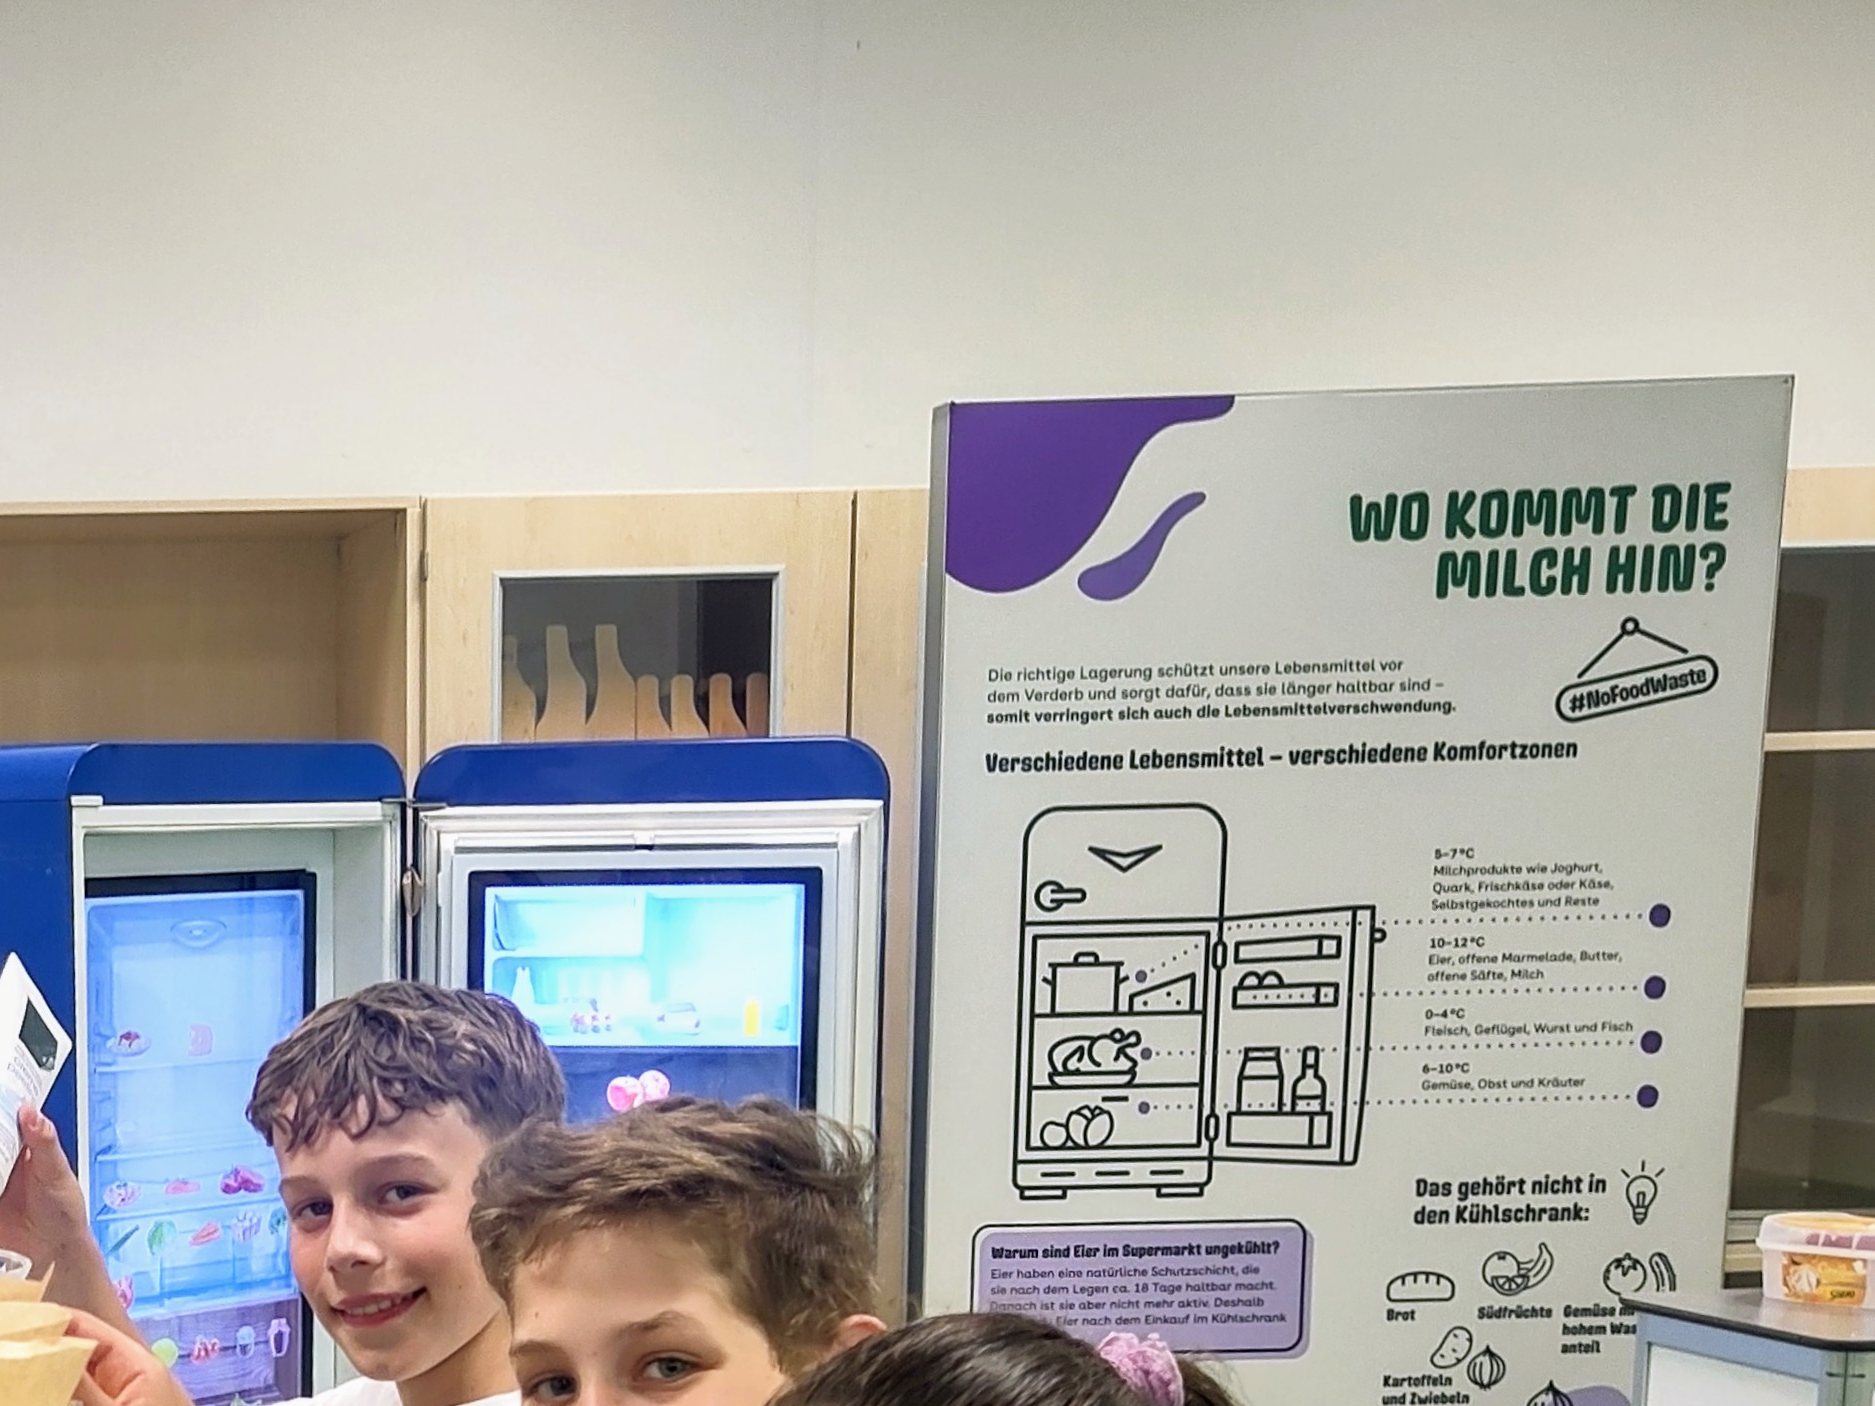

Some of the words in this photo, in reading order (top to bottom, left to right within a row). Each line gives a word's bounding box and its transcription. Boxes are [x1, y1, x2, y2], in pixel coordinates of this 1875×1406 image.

[1350, 492, 1429, 542] WO
[1445, 485, 1637, 539] KOMMT
[1652, 482, 1731, 533] DIE
[1436, 547, 1591, 599] MILCH
[1606, 542, 1725, 594] HIN?
[989, 669, 1012, 682] Die
[1017, 667, 1074, 683] richtige
[1080, 666, 1152, 682] Lagerung
[1157, 664, 1214, 677] schützt
[1220, 665, 1270, 675] unsere
[1275, 659, 1374, 674] Lebensmittel
[1380, 660, 1403, 671] vor
[987, 690, 1019, 703] dem
[1025, 688, 1083, 702] Verderb
[1088, 686, 1116, 700] und
[1121, 686, 1160, 702] sorgt
[1166, 684, 1211, 699] dafür,
[1215, 683, 1251, 697] dass
[1256, 683, 1276, 696] sie
[1281, 681, 1331, 697] länger
[1337, 680, 1394, 694] haltbar
[1400, 678, 1430, 691] sind
[1569, 666, 1707, 714] #NoFoodWaste
[987, 710, 1030, 723] somit
[1035, 708, 1113, 724] verringert
[1118, 706, 1148, 720] sich
[1154, 706, 1191, 719] auch
[1197, 705, 1220, 718] die
[1225, 700, 1456, 717] Lebensmittelverschwendung.
[986, 751, 1123, 772] Verschiedene
[1129, 746, 1263, 769] Lebensmittel
[1289, 742, 1427, 765] verschiedene
[1433, 740, 1578, 761] Komfortzonen
[1434, 865, 1522, 877] Milchprodukte
[1526, 863, 1547, 873] wie
[1551, 863, 1602, 876] Joghurt,
[1433, 882, 1474, 894] Quark,
[1478, 881, 1544, 892] Frischkäse
[1548, 880, 1575, 890] oder
[1579, 878, 1613, 890] Käse,
[1432, 898, 1534, 911] Selbstgekochtes
[1538, 897, 1561, 907] und
[1565, 897, 1600, 906] Reste
[1428, 954, 1455, 966] Eier,
[1459, 953, 1498, 965] offene
[1502, 952, 1576, 963] Marmelade,
[1580, 951, 1622, 962] Butter,
[1428, 971, 1467, 982] offene
[1471, 970, 1507, 981] Säfte,
[1511, 969, 1544, 979] Milch
[1425, 1025, 1471, 1037] Fleisch,
[1475, 1023, 1530, 1037] Geflügel,
[1534, 1023, 1570, 1033] Wurst
[1575, 1022, 1597, 1033] und
[1602, 1021, 1633, 1032] Fisch
[1422, 1080, 1474, 1091] Gemüse,
[1478, 1079, 1507, 1089] Obst
[1511, 1078, 1534, 1088] und
[1538, 1078, 1585, 1088] Kräuter
[1416, 1179, 1452, 1197] Das
[1458, 1176, 1525, 1201] gehört
[1532, 1174, 1583, 1195] nicht
[1588, 1173, 1606, 1194] in
[1414, 1206, 1449, 1225] den
[1456, 1202, 1589, 1224] Kühlschrank:
[991, 1246, 1038, 1259] Warum
[1042, 1244, 1070, 1258] sind
[1074, 1244, 1100, 1257] Eier
[1103, 1243, 1119, 1257] im
[1123, 1243, 1201, 1259] Supermarkt
[1205, 1241, 1279, 1258] ungekühlt?
[991, 1269, 1013, 1279] Eier
[1017, 1267, 1054, 1279] haben
[1058, 1267, 1082, 1278] eine
[1086, 1266, 1147, 1277] natürliche
[1151, 1265, 1238, 1277] Schutzschicht,
[1242, 1265, 1260, 1275] die
[991, 1285, 1006, 1295] sie
[1010, 1284, 1039, 1295] nach
[1043, 1283, 1069, 1294] dem
[1073, 1283, 1108, 1297] Legen
[1112, 1285, 1130, 1293] ca.
[1134, 1282, 1148, 1293] 18
[1152, 1282, 1181, 1295] Tage
[1185, 1281, 1231, 1292] haltbar
[1040, 1300, 1054, 1311] ist
[1058, 1300, 1075, 1311] sie
[1079, 1299, 1106, 1310] aber
[1109, 1298, 1140, 1310] nicht
[1144, 1298, 1173, 1308] mehr
[1214, 1297, 1264, 1308] Deshalb
[1082, 1315, 1111, 1326] nach
[1115, 1315, 1140, 1325] dem
[1145, 1314, 1190, 1324] Einkauf
[1194, 1314, 1207, 1324] im
[1211, 1313, 1287, 1323] Kühlschrank
[1387, 1309, 1416, 1321] Brot
[1478, 1306, 1552, 1319] Südfrüchte
[1563, 1305, 1615, 1317] Gemüse
[1562, 1323, 1606, 1335] hohem
[1561, 1341, 1600, 1353] anteil
[1383, 1375, 1452, 1387] Kartoffeln
[1382, 1394, 1407, 1405] und
[1410, 1393, 1469, 1404] Zwiebeln
